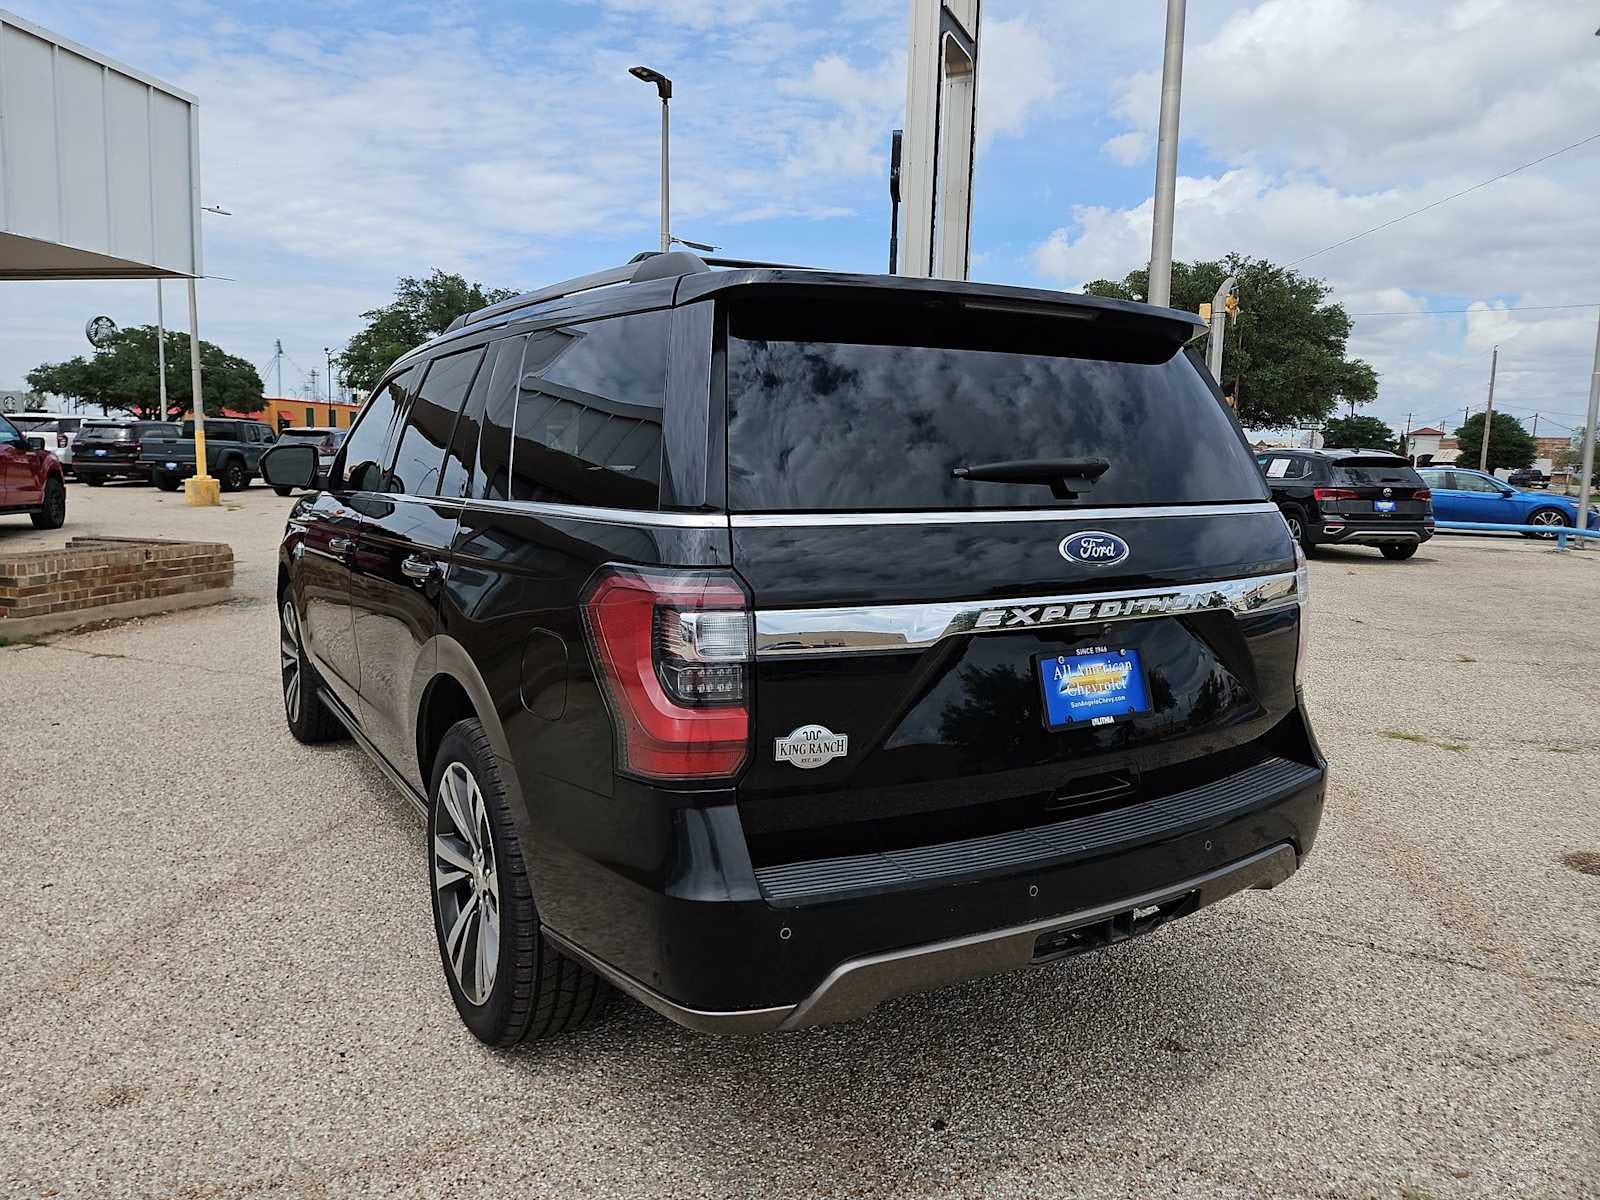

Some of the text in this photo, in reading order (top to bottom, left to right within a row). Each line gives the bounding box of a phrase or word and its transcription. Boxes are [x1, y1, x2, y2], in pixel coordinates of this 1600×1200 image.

[1080, 537, 1115, 559] Ford
[975, 592, 1215, 628] EXPEDITION
[1076, 647, 1094, 656] SINCE
[1053, 660, 1132, 680] All American
[1066, 677, 1127, 696] Chevrolet
[780, 740, 844, 756] KING RANCH
